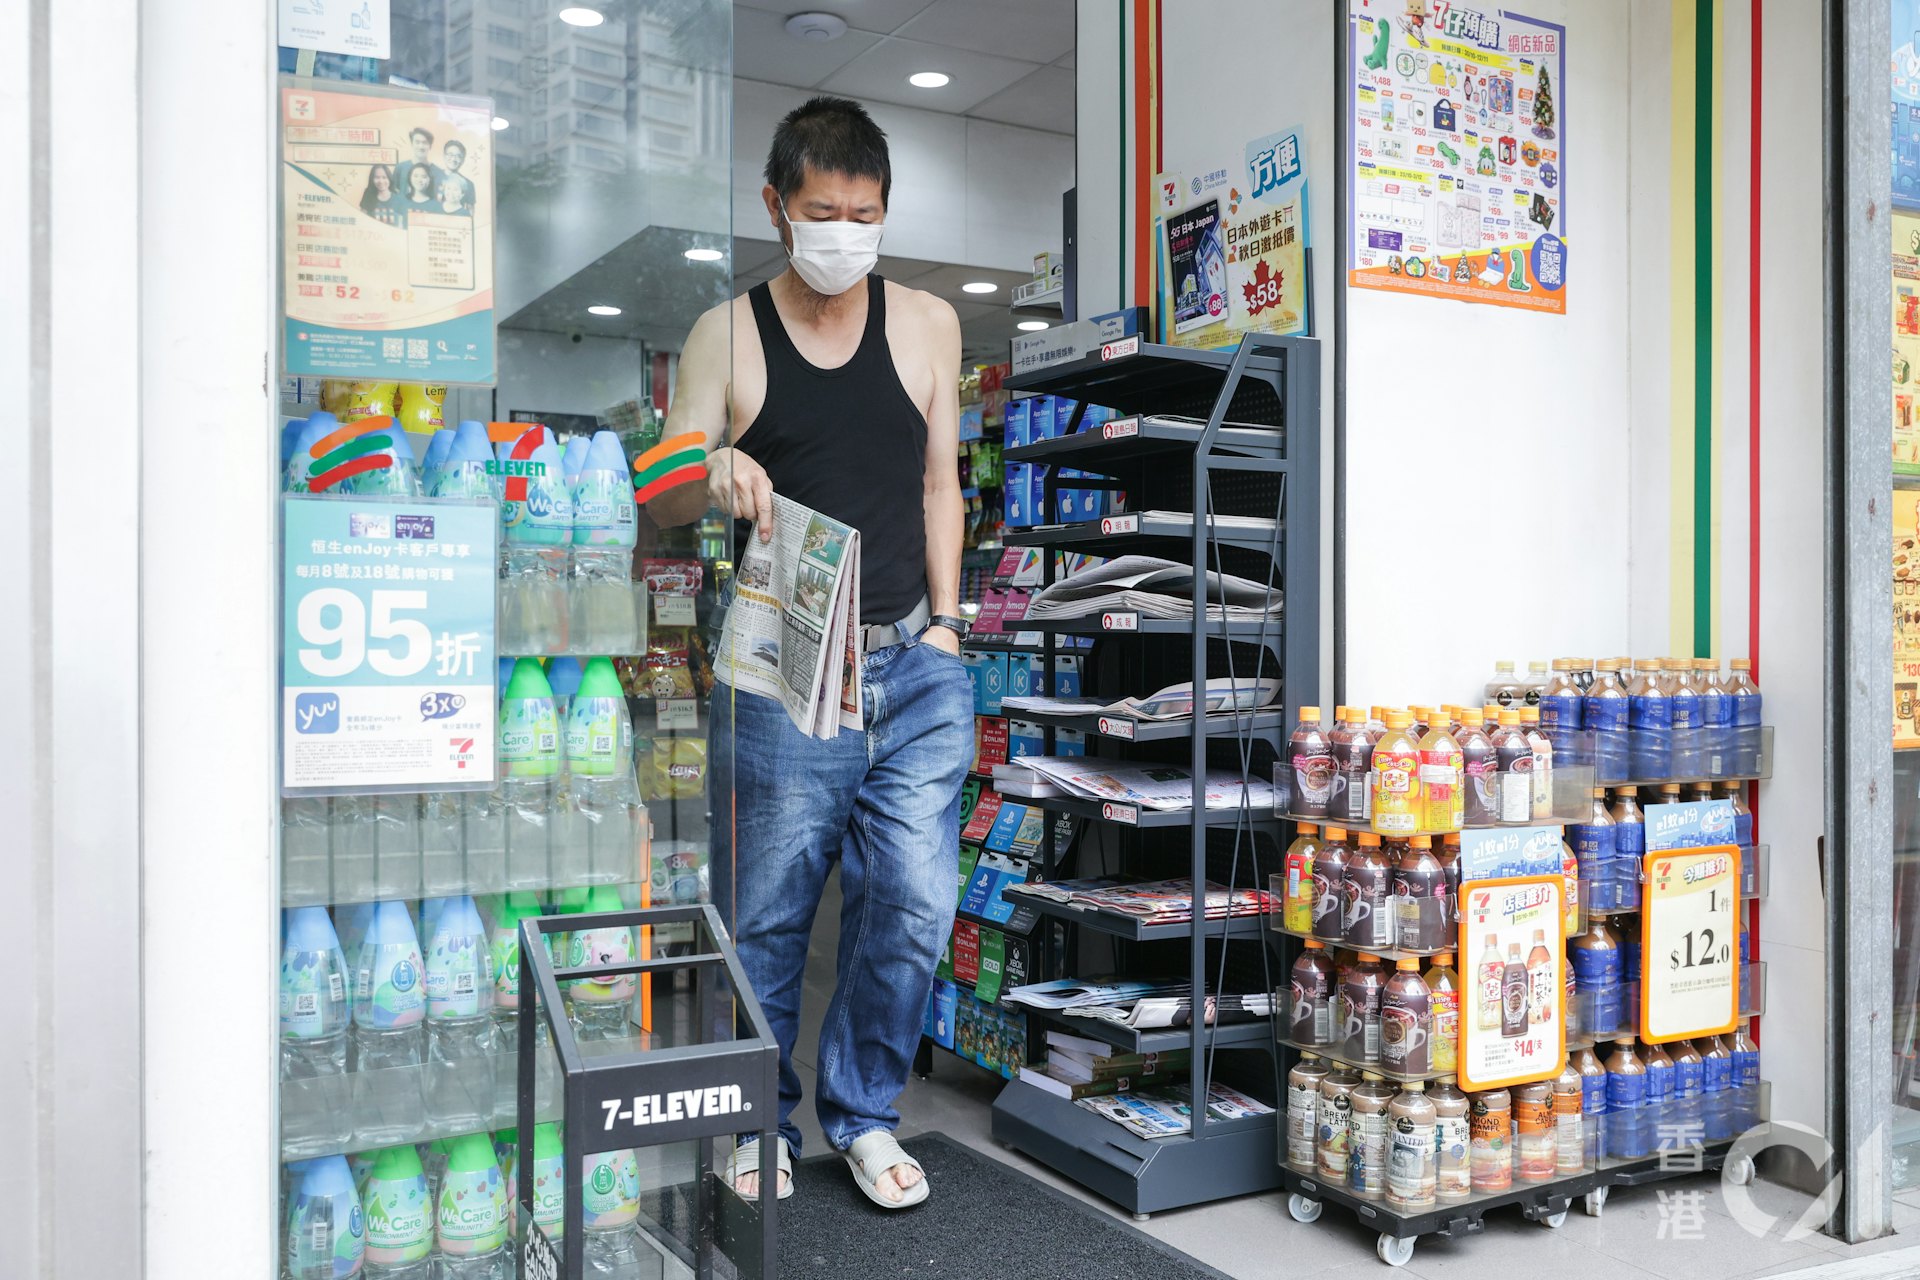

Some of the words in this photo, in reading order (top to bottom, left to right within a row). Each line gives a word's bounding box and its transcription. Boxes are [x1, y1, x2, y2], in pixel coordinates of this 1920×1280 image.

[1507, 34, 1556, 53] 網店新品
[1370, 74, 1392, 87] $1,488
[1435, 86, 1450, 97] $488
[1411, 126, 1427, 137] $250
[1250, 134, 1302, 199] 方便
[1203, 169, 1228, 183] 中國移動
[1181, 222, 1194, 235] 日本
[1195, 214, 1214, 229] Japan
[1227, 209, 1283, 245] 日本外遊卡
[1238, 225, 1295, 262] 秋日激抵價
[1249, 280, 1279, 310] $58
[1112, 341, 1136, 357] 東方日報
[581, 501, 610, 514] Care
[298, 700, 337, 730] yuu
[502, 732, 529, 745] Care
[987, 736, 1006, 744] ONLINE
[1055, 820, 1071, 829] XBOX
[1683, 857, 1727, 885] 今期推介
[1503, 884, 1551, 916] 店長推介
[1708, 889, 1718, 912] 1
[1720, 897, 1730, 912] 件
[960, 937, 977, 949] ONLINE
[1670, 928, 1730, 972] $12.0
[984, 960, 999, 971] GOLD
[1009, 959, 1023, 968] XBOX
[1324, 1110, 1348, 1121] BREW
[1329, 1117, 1349, 1127] LATT
[1473, 1117, 1499, 1126] MOND
[1392, 1131, 1424, 1147] WANTED
[1472, 1129, 1488, 1137] ATTE
[368, 1215, 389, 1232] We
[391, 1216, 422, 1231] Care
[441, 1208, 458, 1224] We
[461, 1209, 492, 1223] Care
